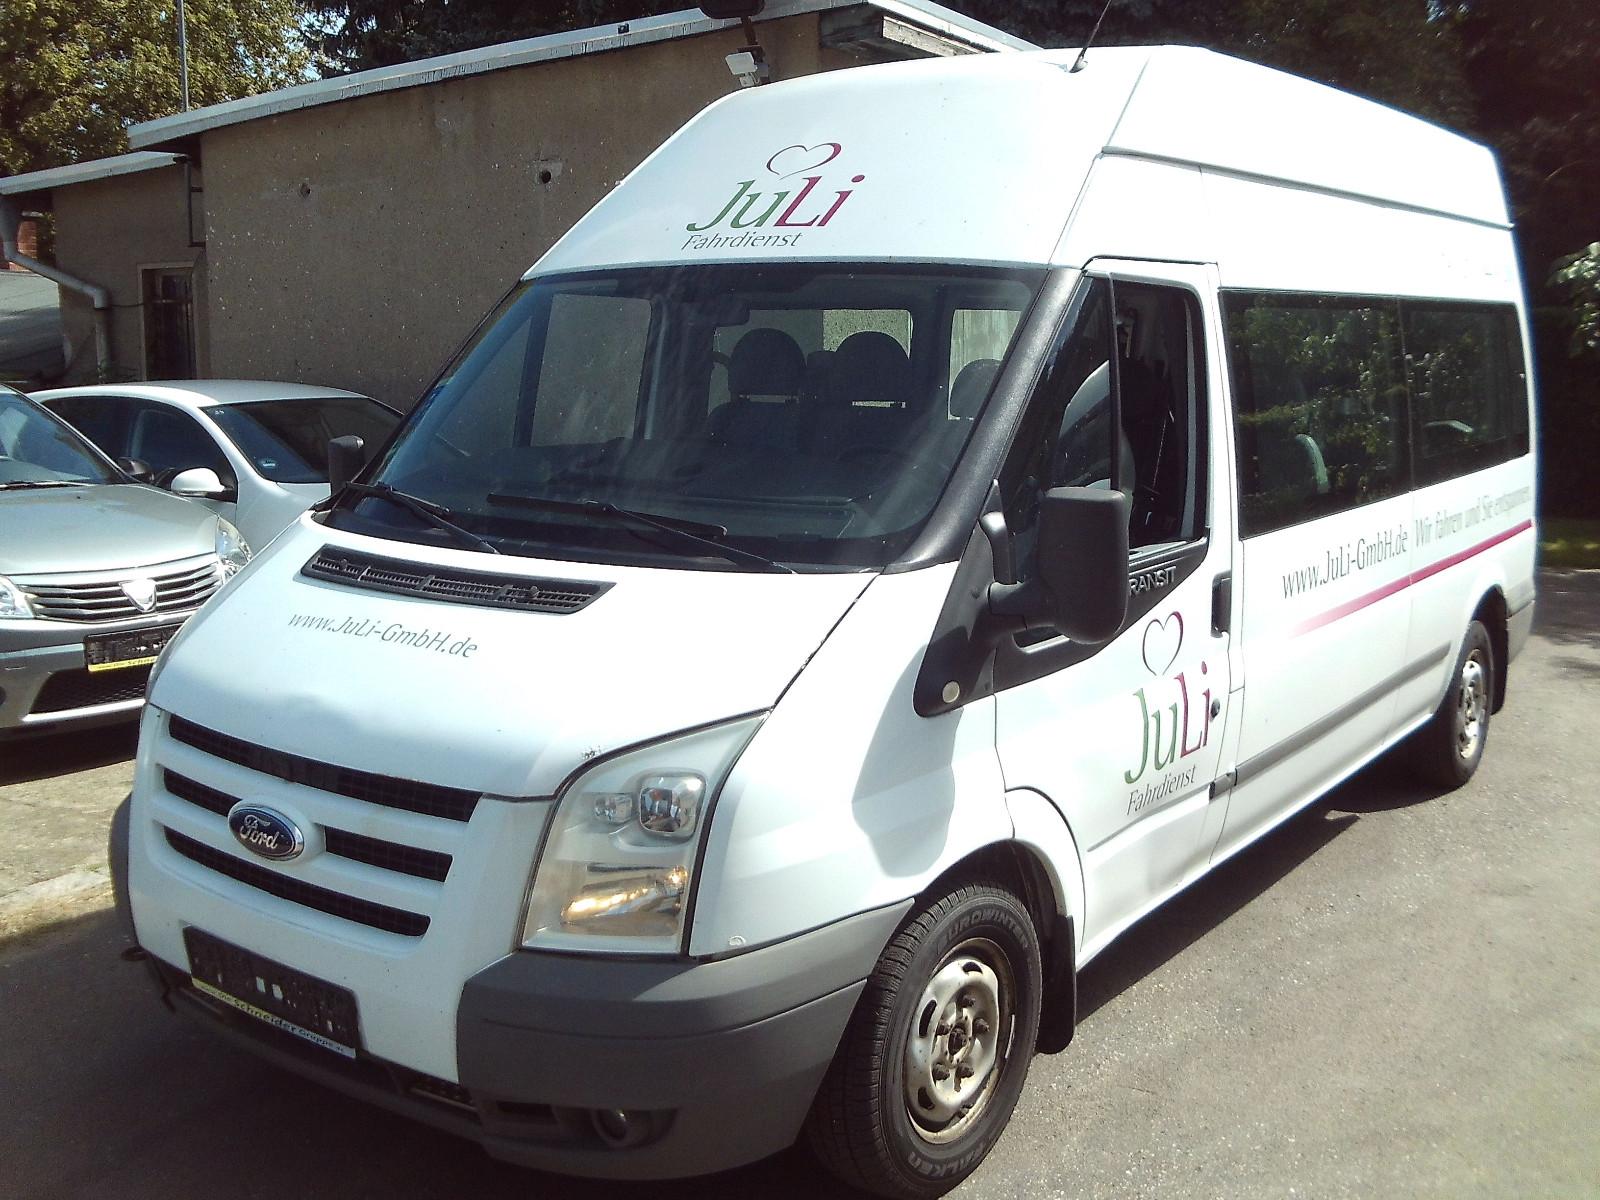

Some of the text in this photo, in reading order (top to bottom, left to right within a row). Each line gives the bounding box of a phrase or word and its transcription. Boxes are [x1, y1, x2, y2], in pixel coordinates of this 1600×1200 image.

[686, 174, 865, 231] JuLi
[681, 231, 804, 250] Fahrdienst
[1128, 565, 1177, 597] RANSIT
[1282, 524, 1409, 599] www.JuLi-GmbH.de
[1415, 516, 1433, 548] Wir
[288, 613, 479, 658] www.JuLi-GmbH.de
[1124, 660, 1211, 785] JuLi
[1127, 764, 1197, 815] Fahrdienst
[240, 814, 280, 849] Ford
